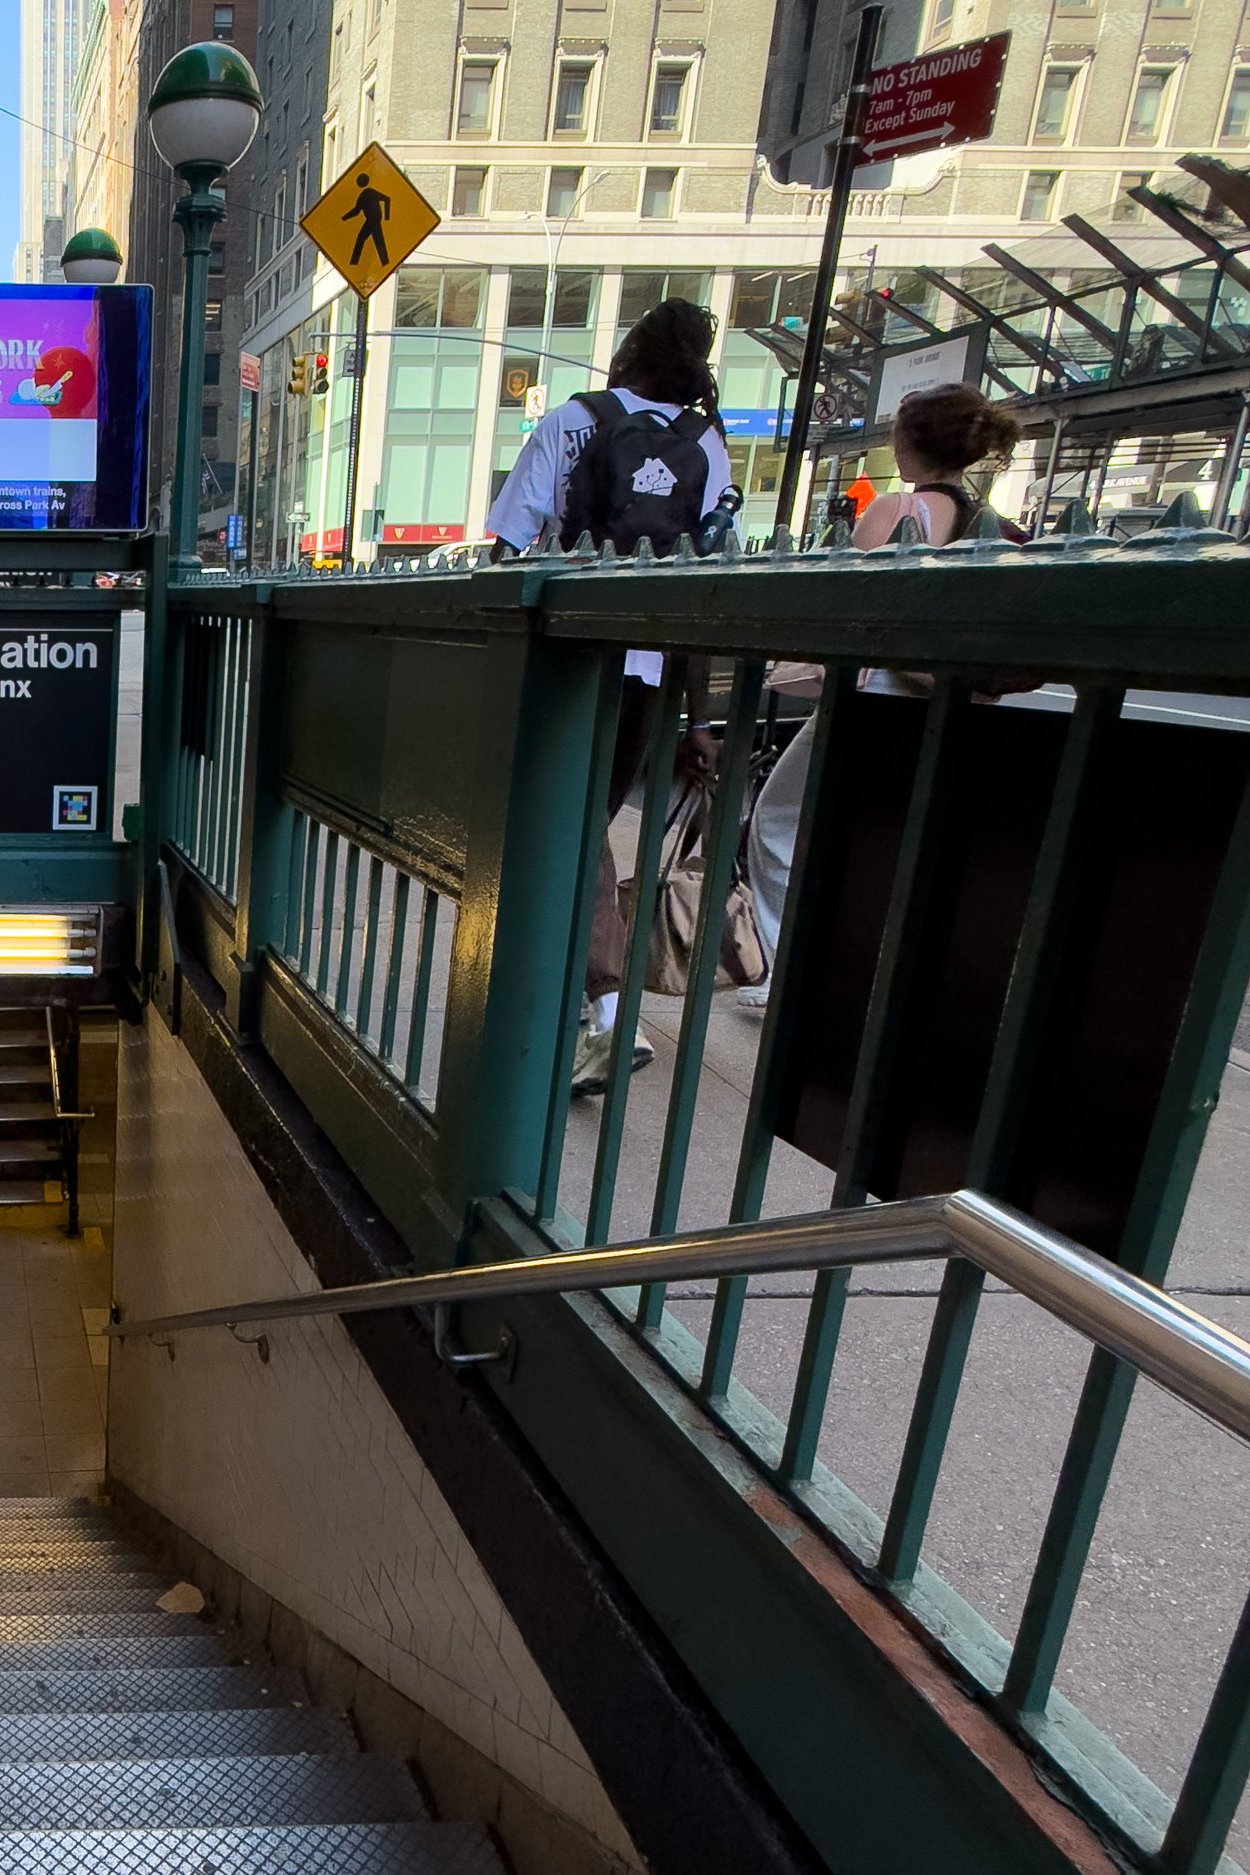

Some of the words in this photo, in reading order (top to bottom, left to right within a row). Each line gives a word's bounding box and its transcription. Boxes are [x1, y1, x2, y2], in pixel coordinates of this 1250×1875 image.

[872, 74, 894, 95] NO
[898, 49, 982, 87] STANDING
[869, 97, 894, 115] 7am
[906, 88, 933, 107] 7pm
[865, 112, 906, 134] Except
[908, 101, 956, 123] Sunday
[1197, 459, 1213, 480] 4
[33, 486, 67, 497] trains,
[24, 500, 49, 510] Park
[51, 500, 65, 510] Av
